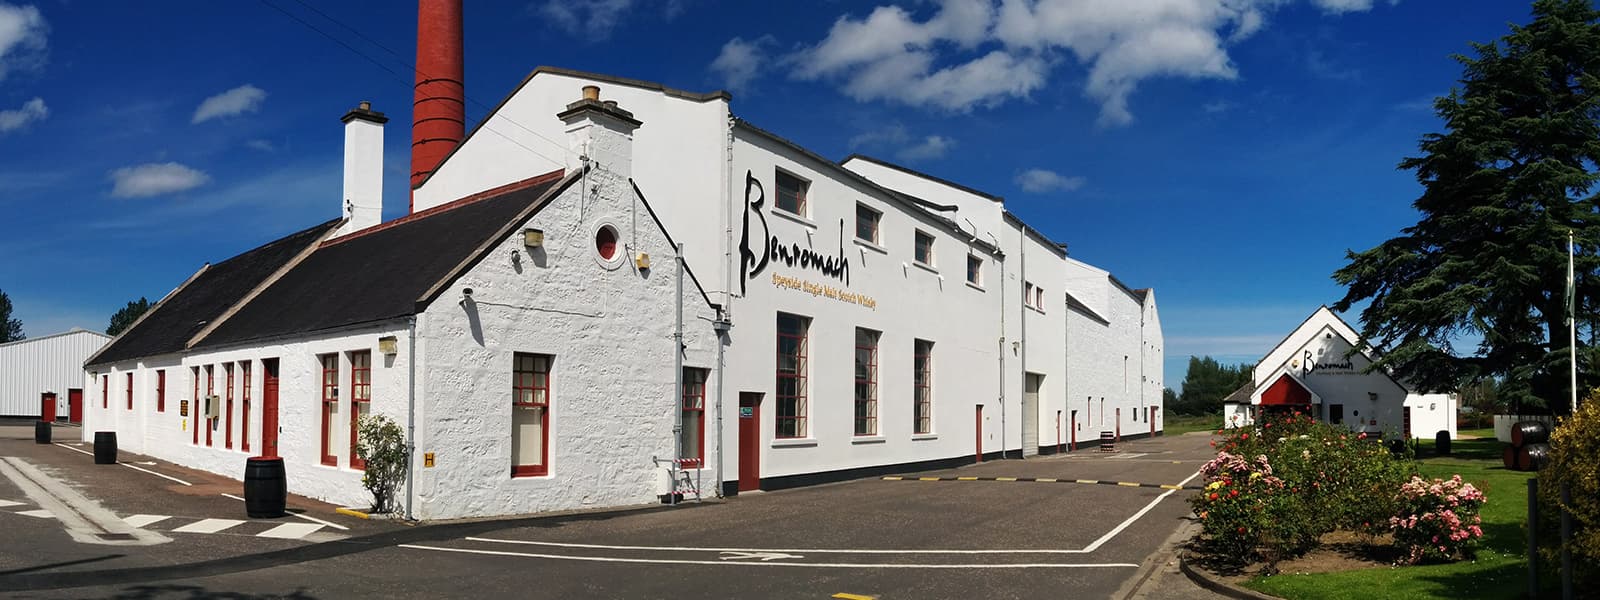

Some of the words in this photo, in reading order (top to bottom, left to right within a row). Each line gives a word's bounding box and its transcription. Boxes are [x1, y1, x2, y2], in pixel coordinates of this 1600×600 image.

[739, 169, 849, 297] Benromach
[772, 272, 801, 291] Speyside
[803, 280, 822, 297] Single
[824, 285, 838, 300] Malt
[839, 290, 856, 304] Scotch
[857, 294, 876, 311] Whisky
[1303, 350, 1353, 379] Benromach
[425, 453, 434, 466] H
